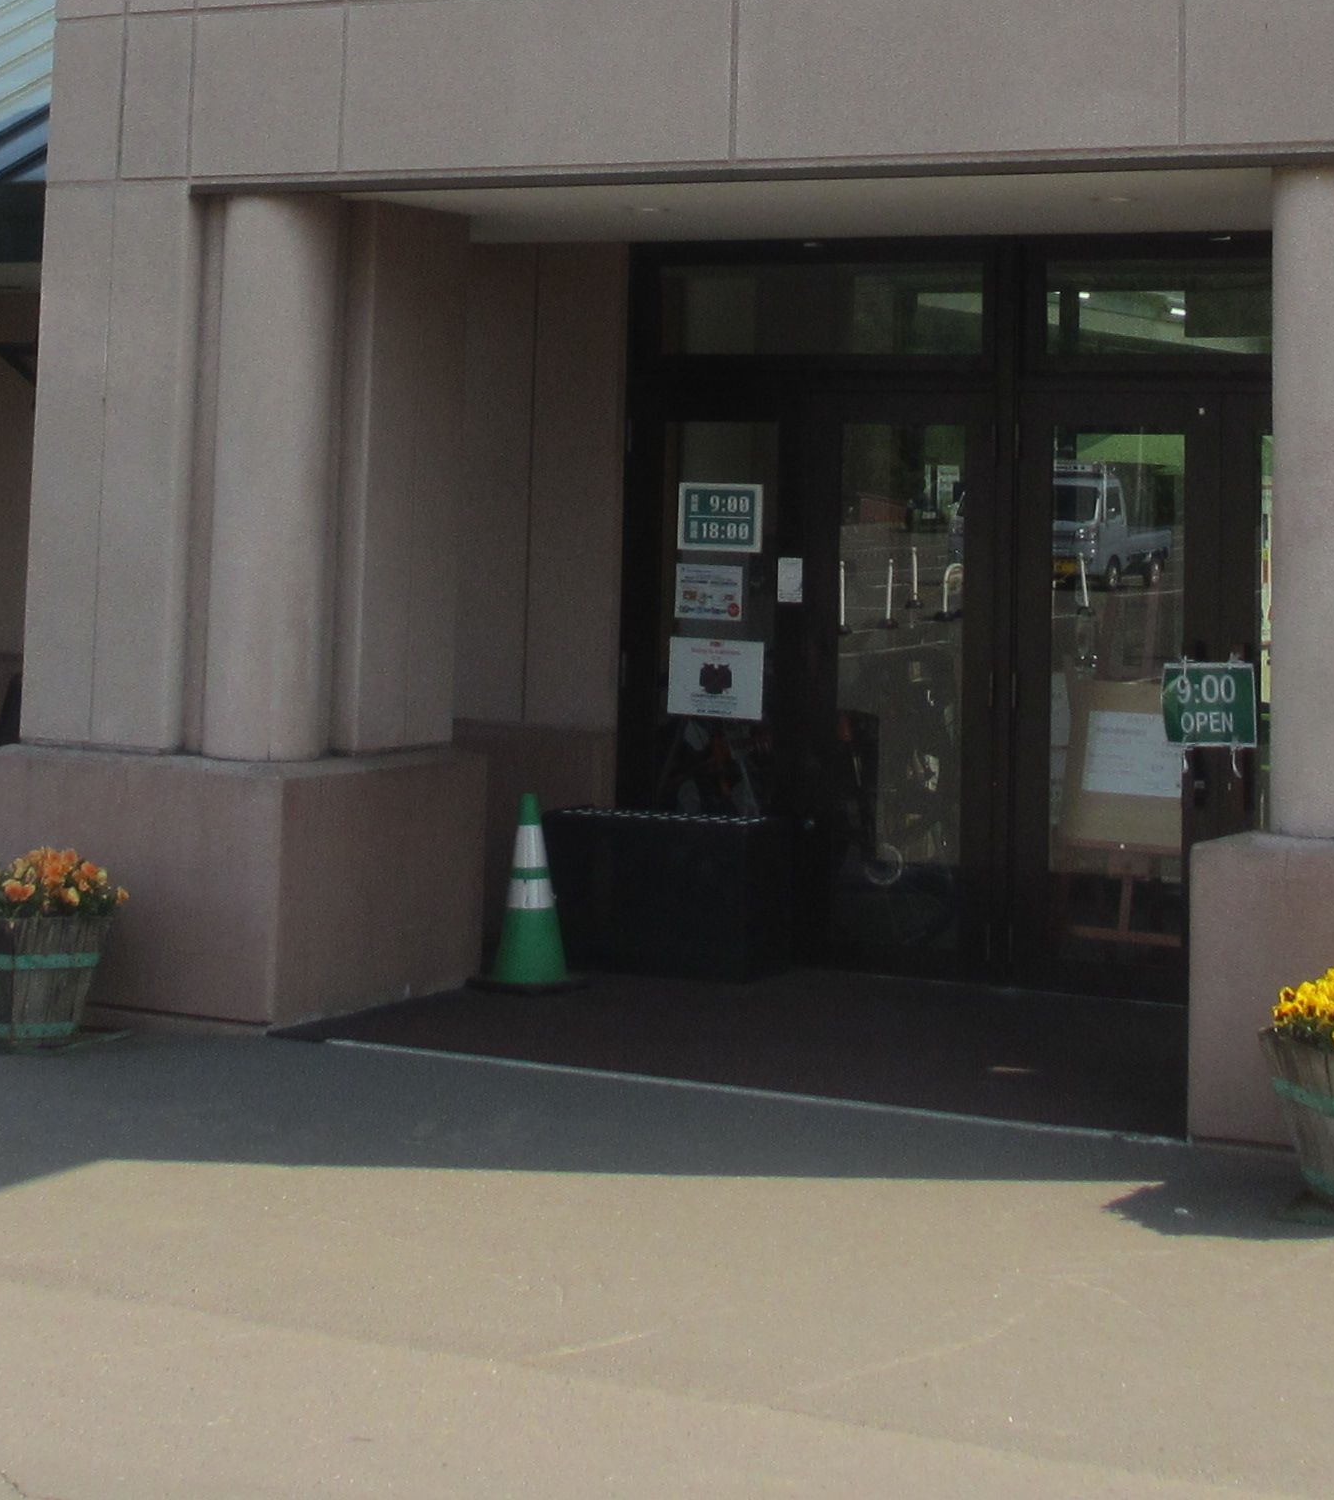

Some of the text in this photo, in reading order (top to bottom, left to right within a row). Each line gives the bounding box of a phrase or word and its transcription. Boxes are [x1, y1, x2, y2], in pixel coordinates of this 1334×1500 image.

[710, 495, 750, 514] 9:00
[701, 522, 750, 540] 18:00
[1177, 674, 1236, 703] 9:00
[1180, 712, 1234, 733] OPEN
